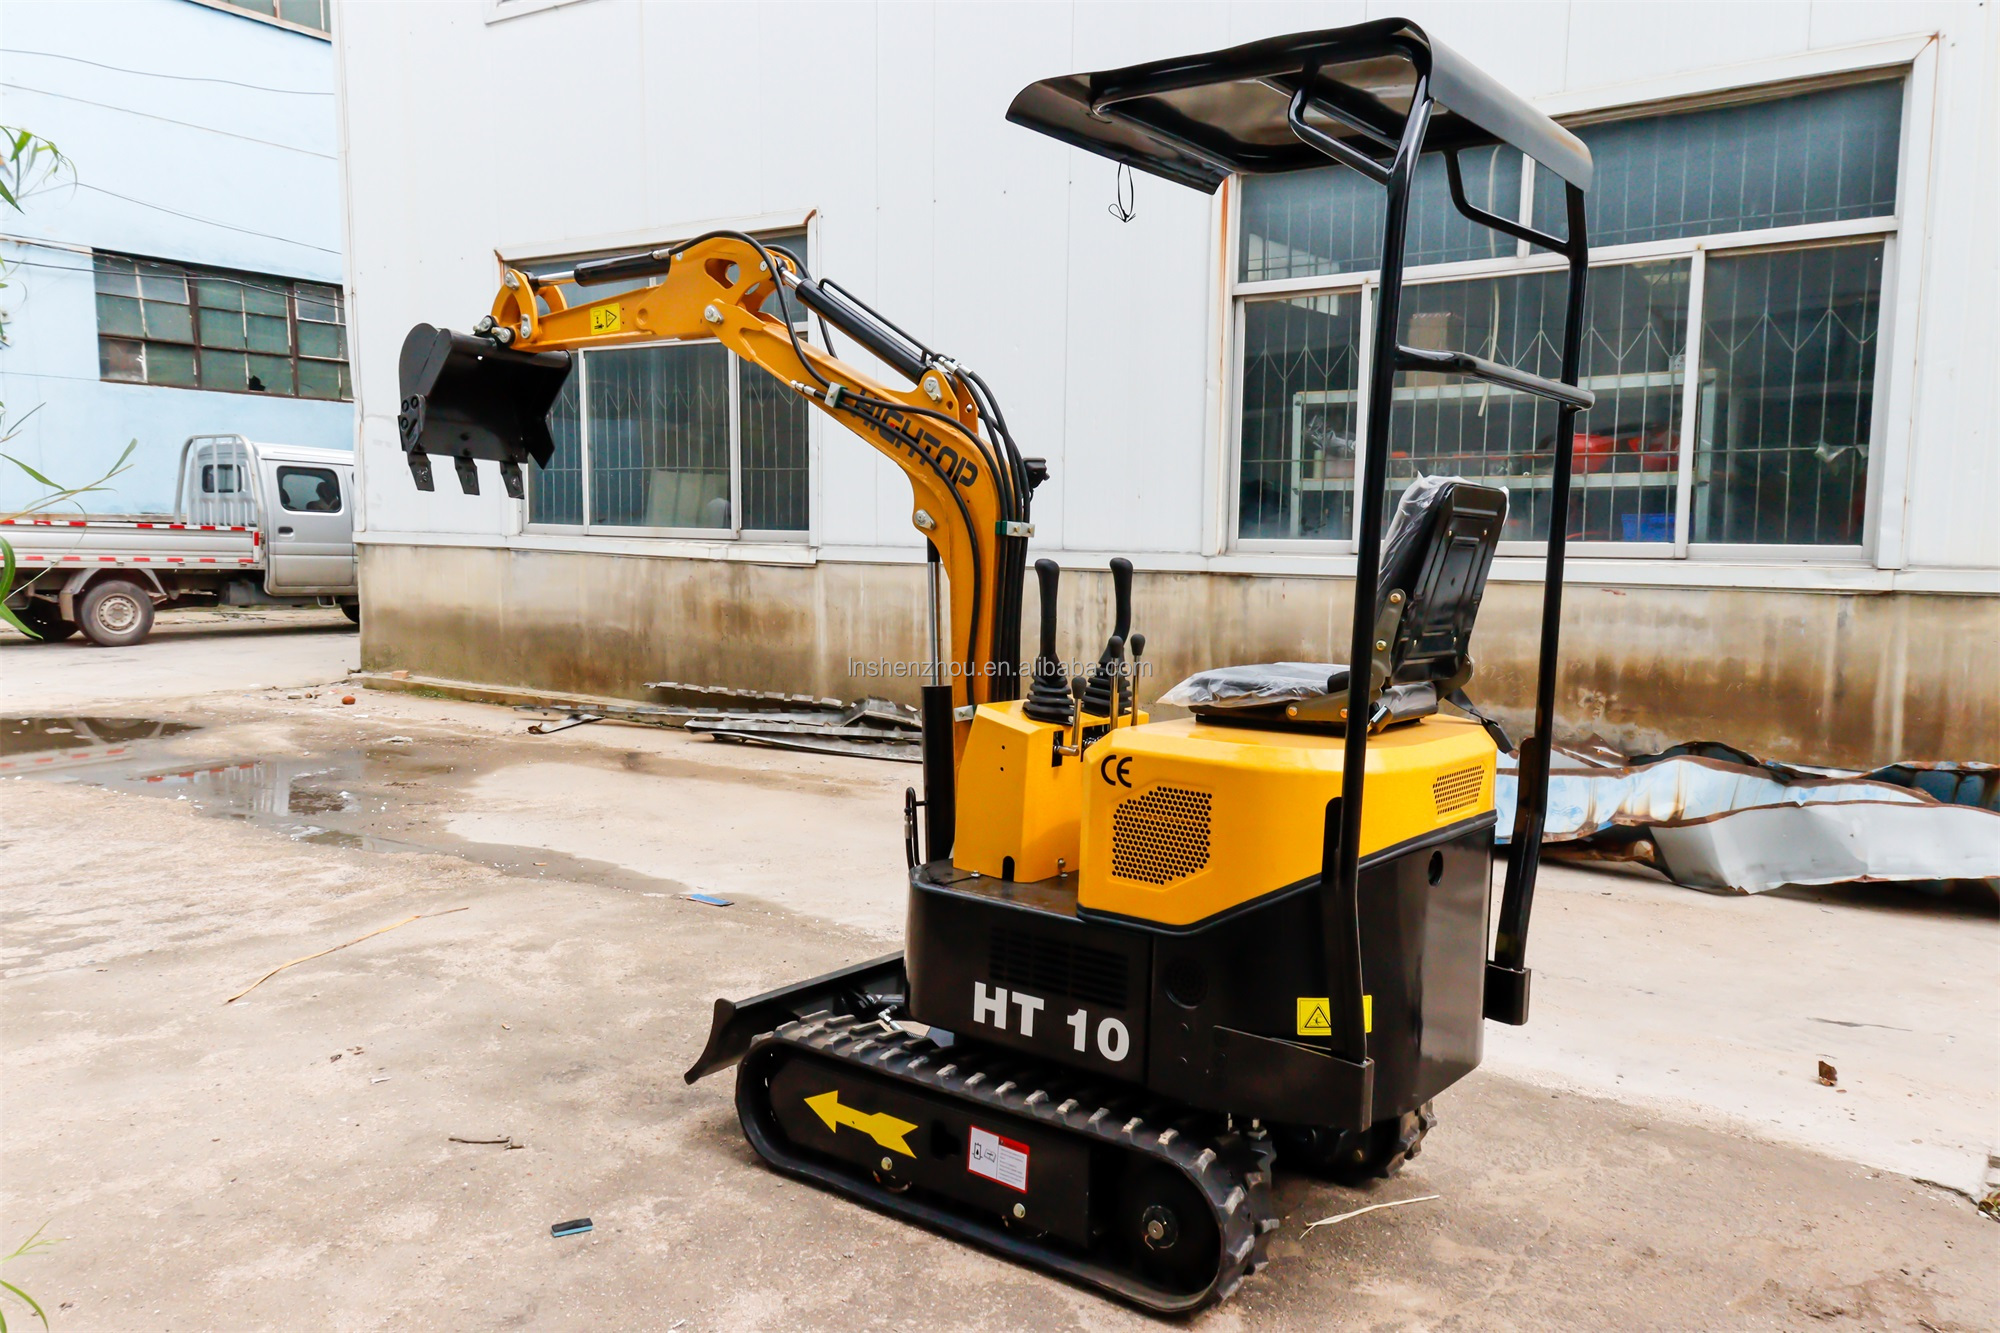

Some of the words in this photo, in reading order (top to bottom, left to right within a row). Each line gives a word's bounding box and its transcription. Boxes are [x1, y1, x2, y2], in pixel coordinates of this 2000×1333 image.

[1100, 754, 1133, 789] CE
[973, 981, 1045, 1038] HT
[1066, 1008, 1130, 1062] 10
